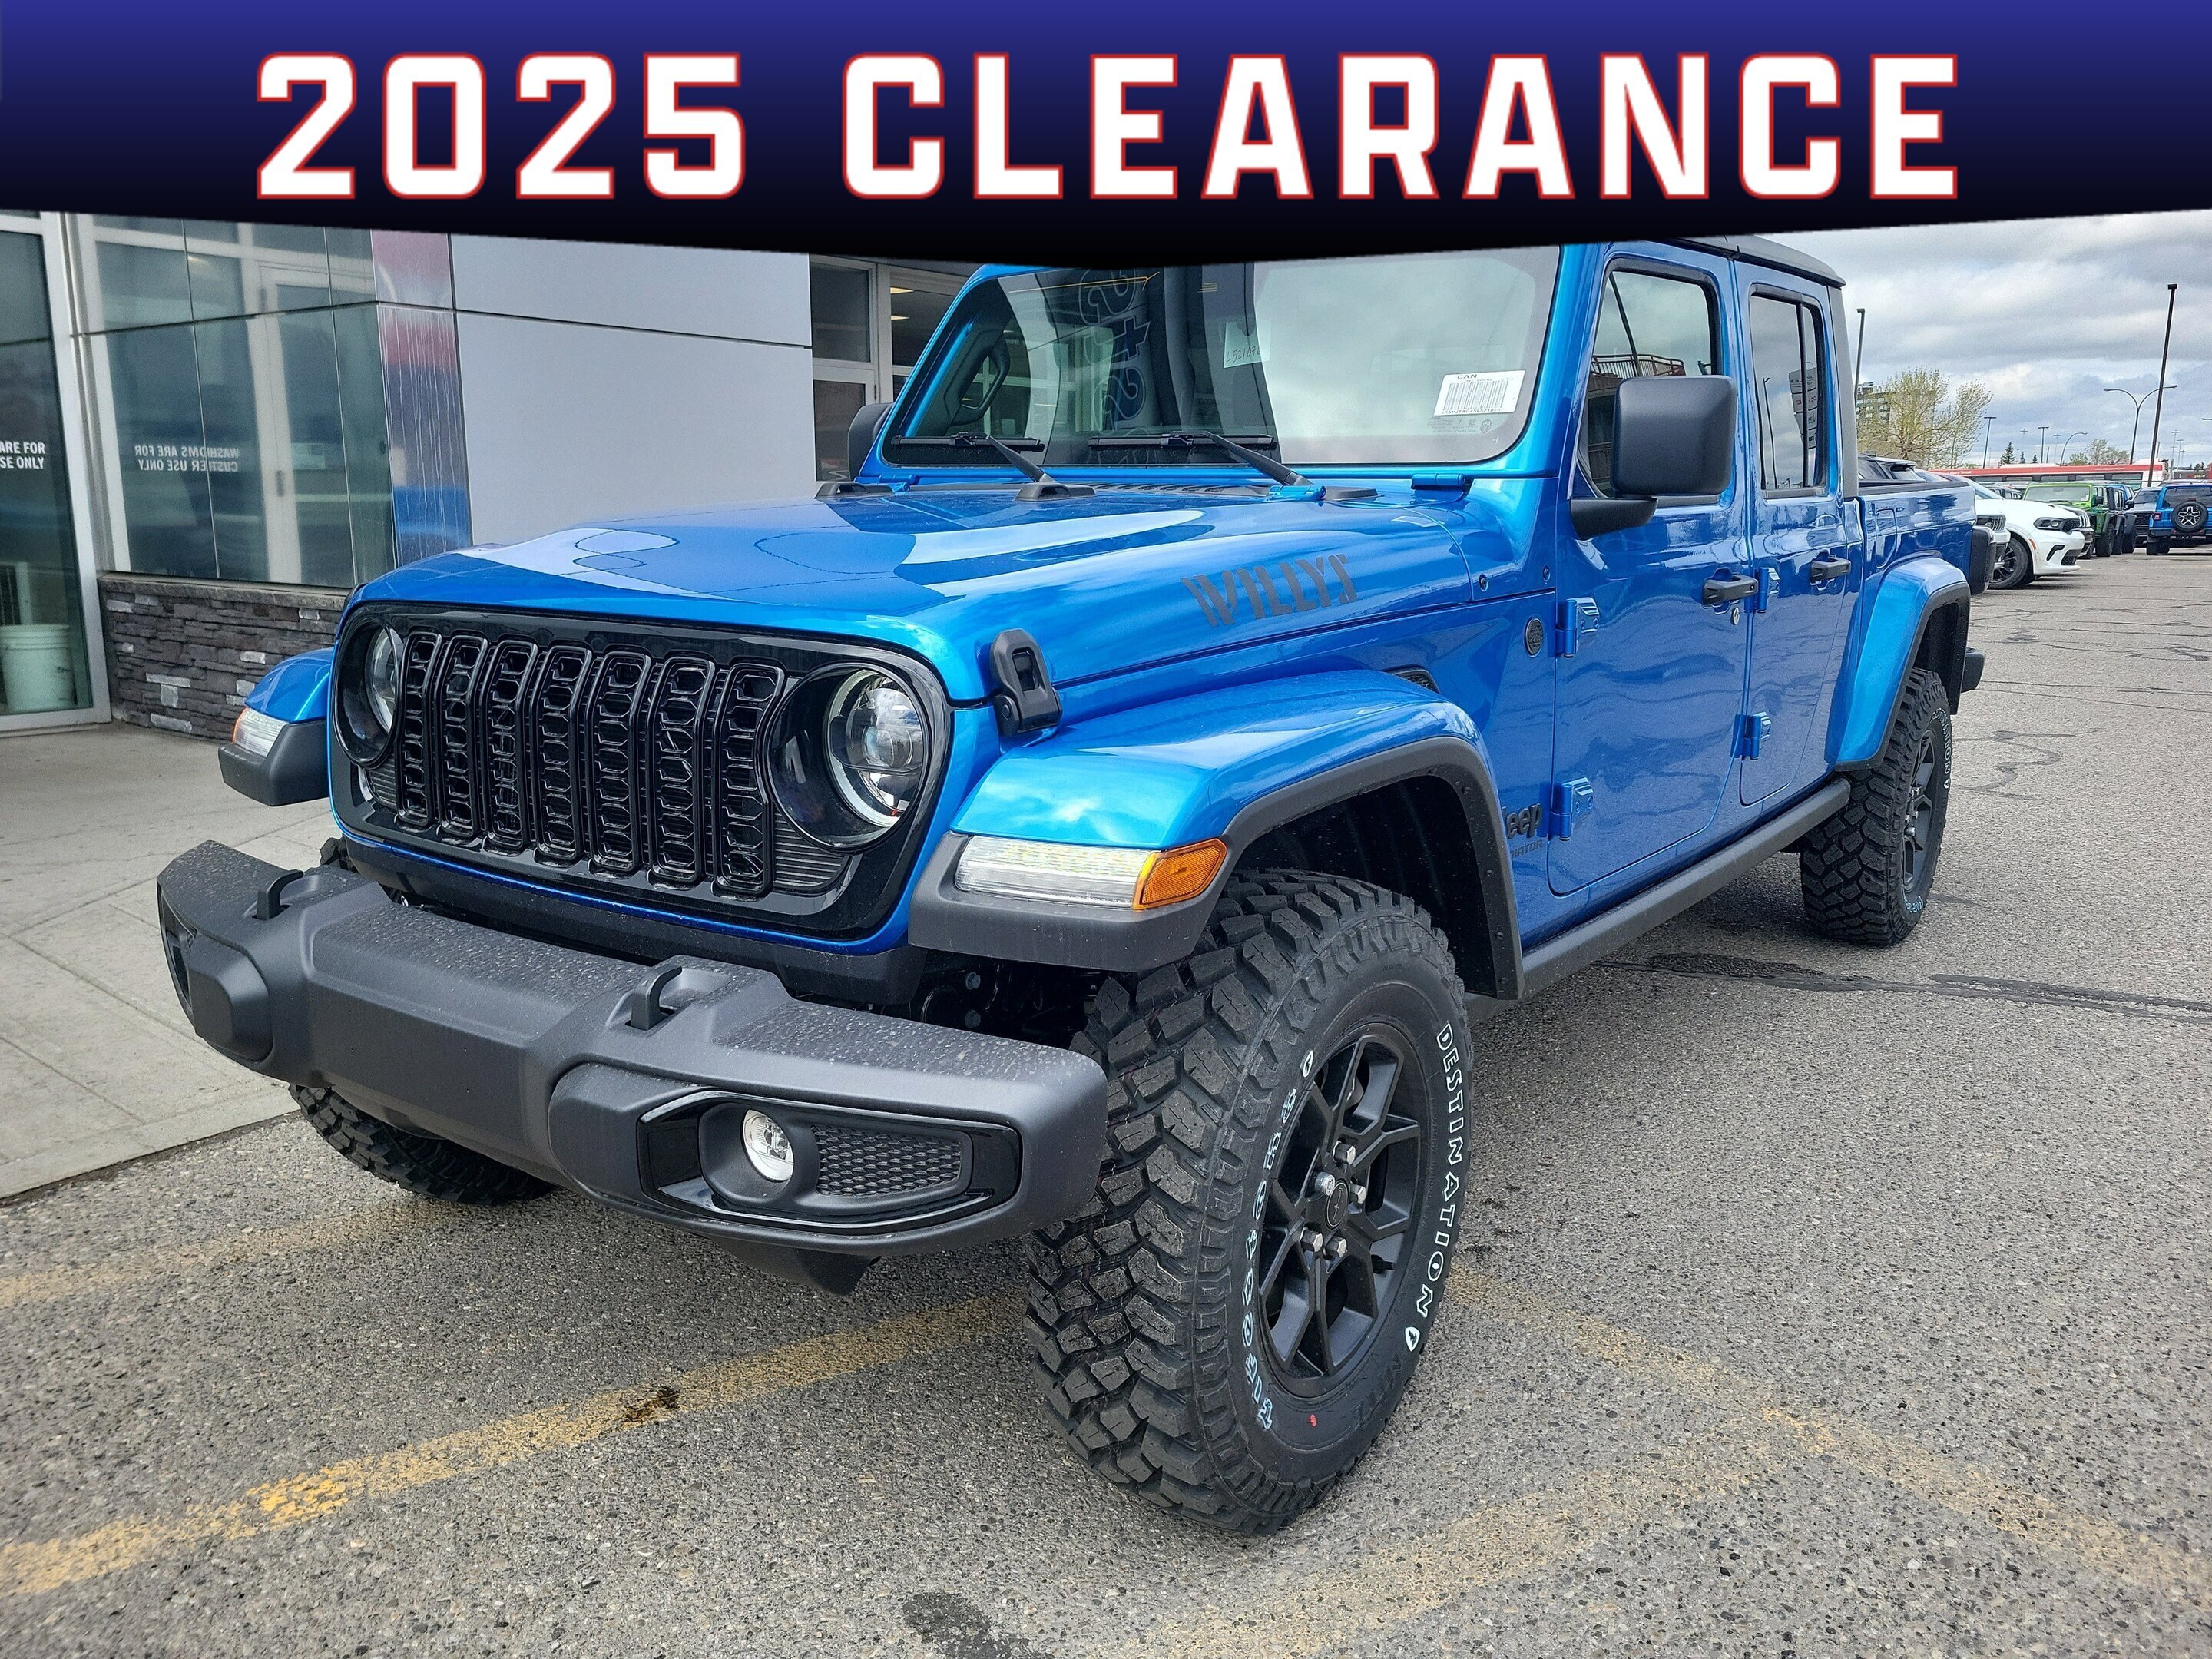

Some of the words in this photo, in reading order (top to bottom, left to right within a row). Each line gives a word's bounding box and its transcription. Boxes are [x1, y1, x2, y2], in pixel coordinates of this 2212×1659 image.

[0, 440, 21, 454] ARE
[23, 441, 46, 454] FOR
[16, 455, 44, 469] ONLY
[1180, 553, 1357, 628] WILLYS
[1502, 802, 1542, 839] eep
[1416, 1022, 1464, 1318] DESTINATION
